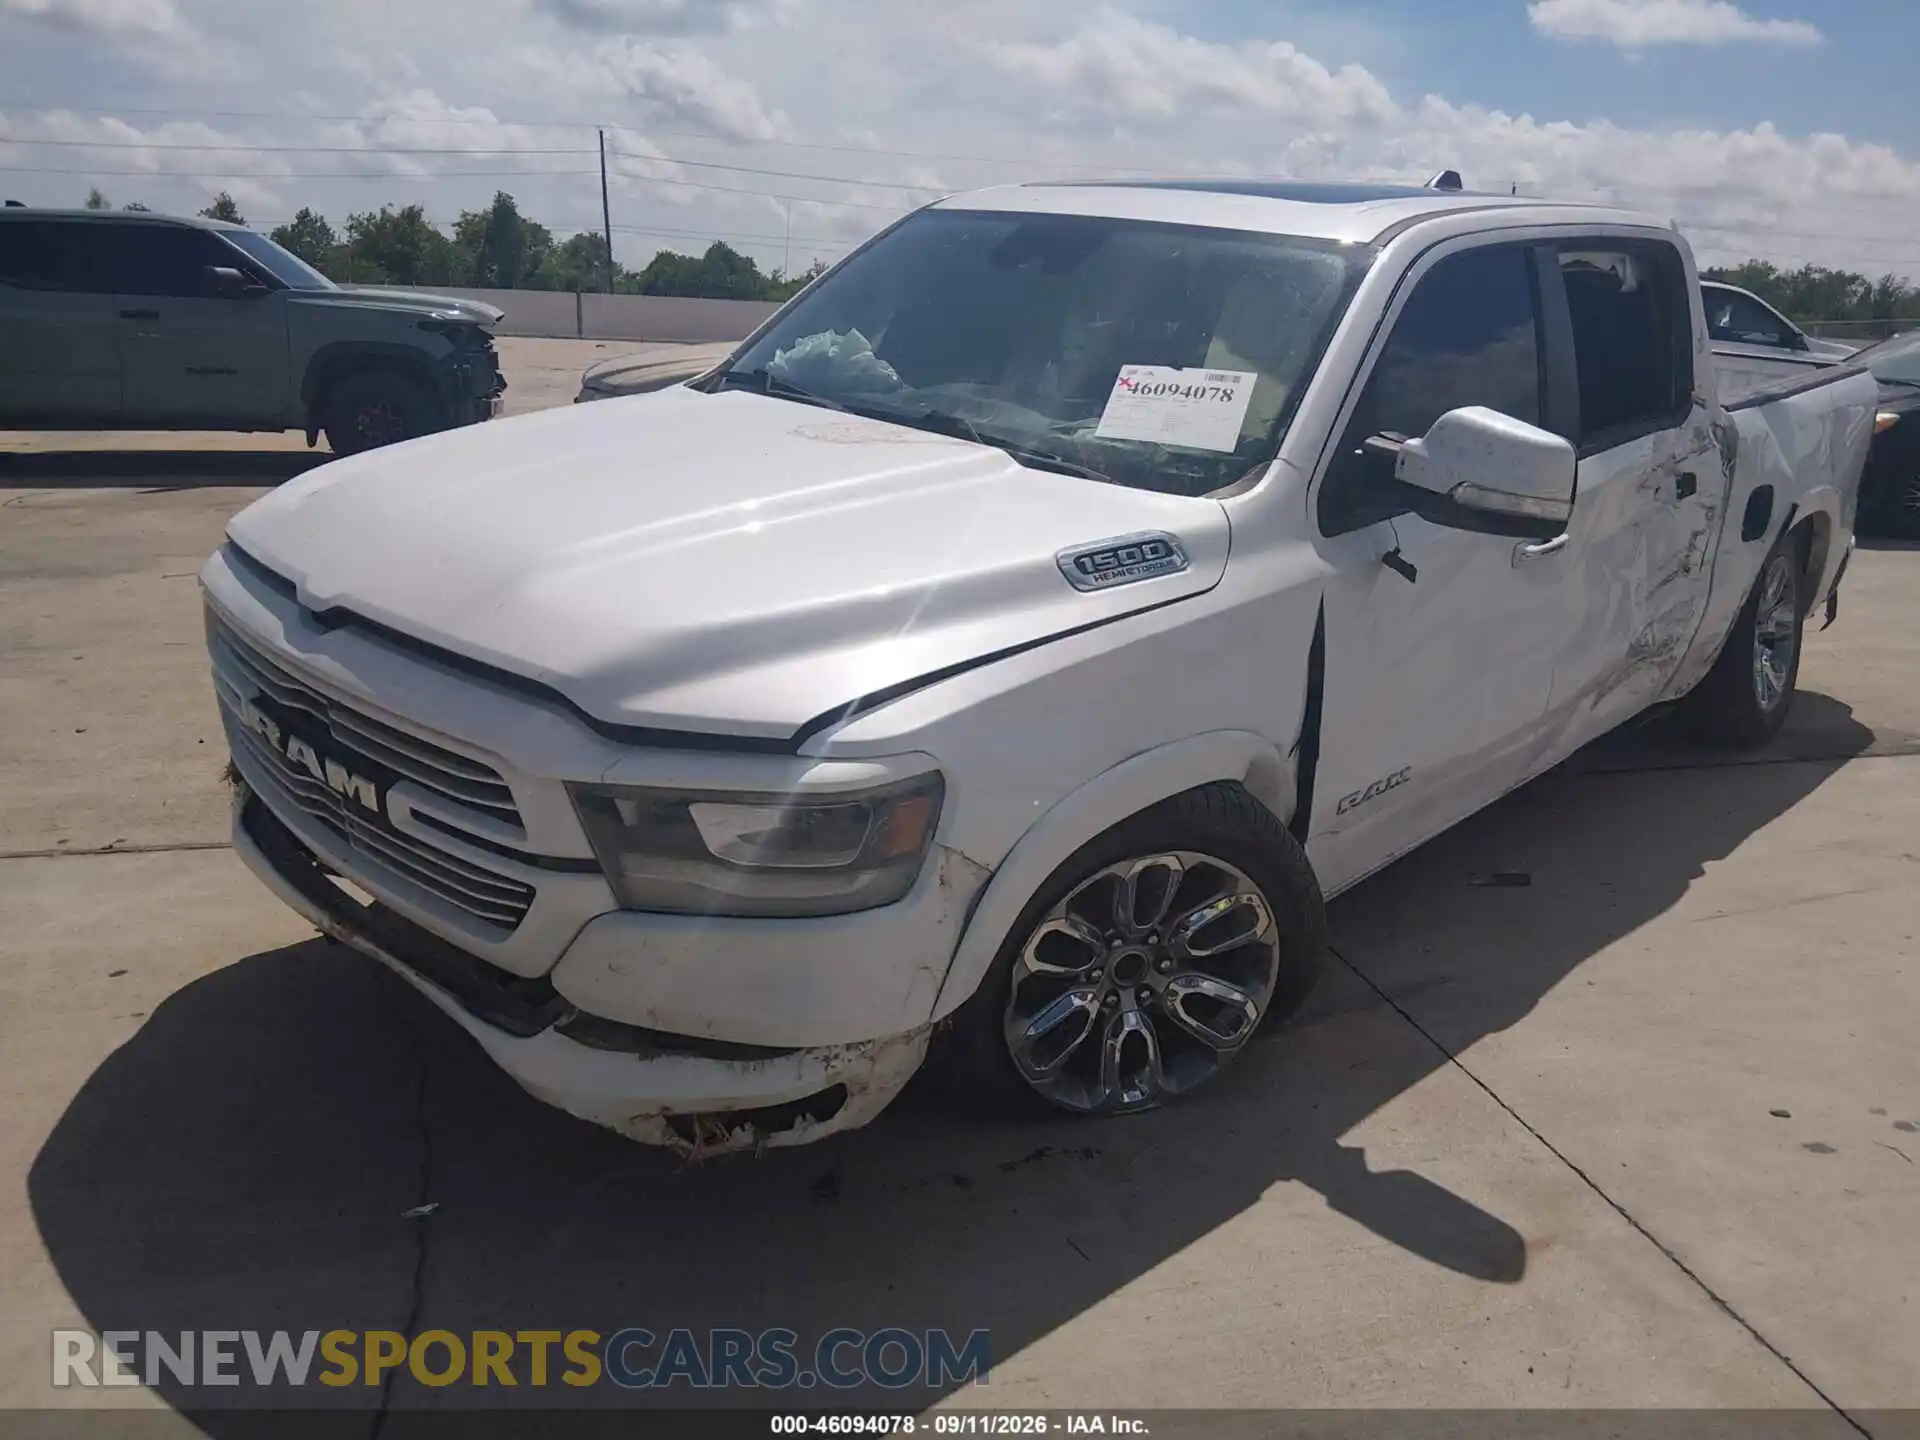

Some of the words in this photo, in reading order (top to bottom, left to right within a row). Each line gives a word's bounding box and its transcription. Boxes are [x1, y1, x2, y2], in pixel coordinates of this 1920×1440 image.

[1127, 381, 1235, 403] 46094078
[1079, 541, 1166, 573] 1500
[241, 699, 379, 812] RAM
[1336, 765, 1411, 816] RAM
